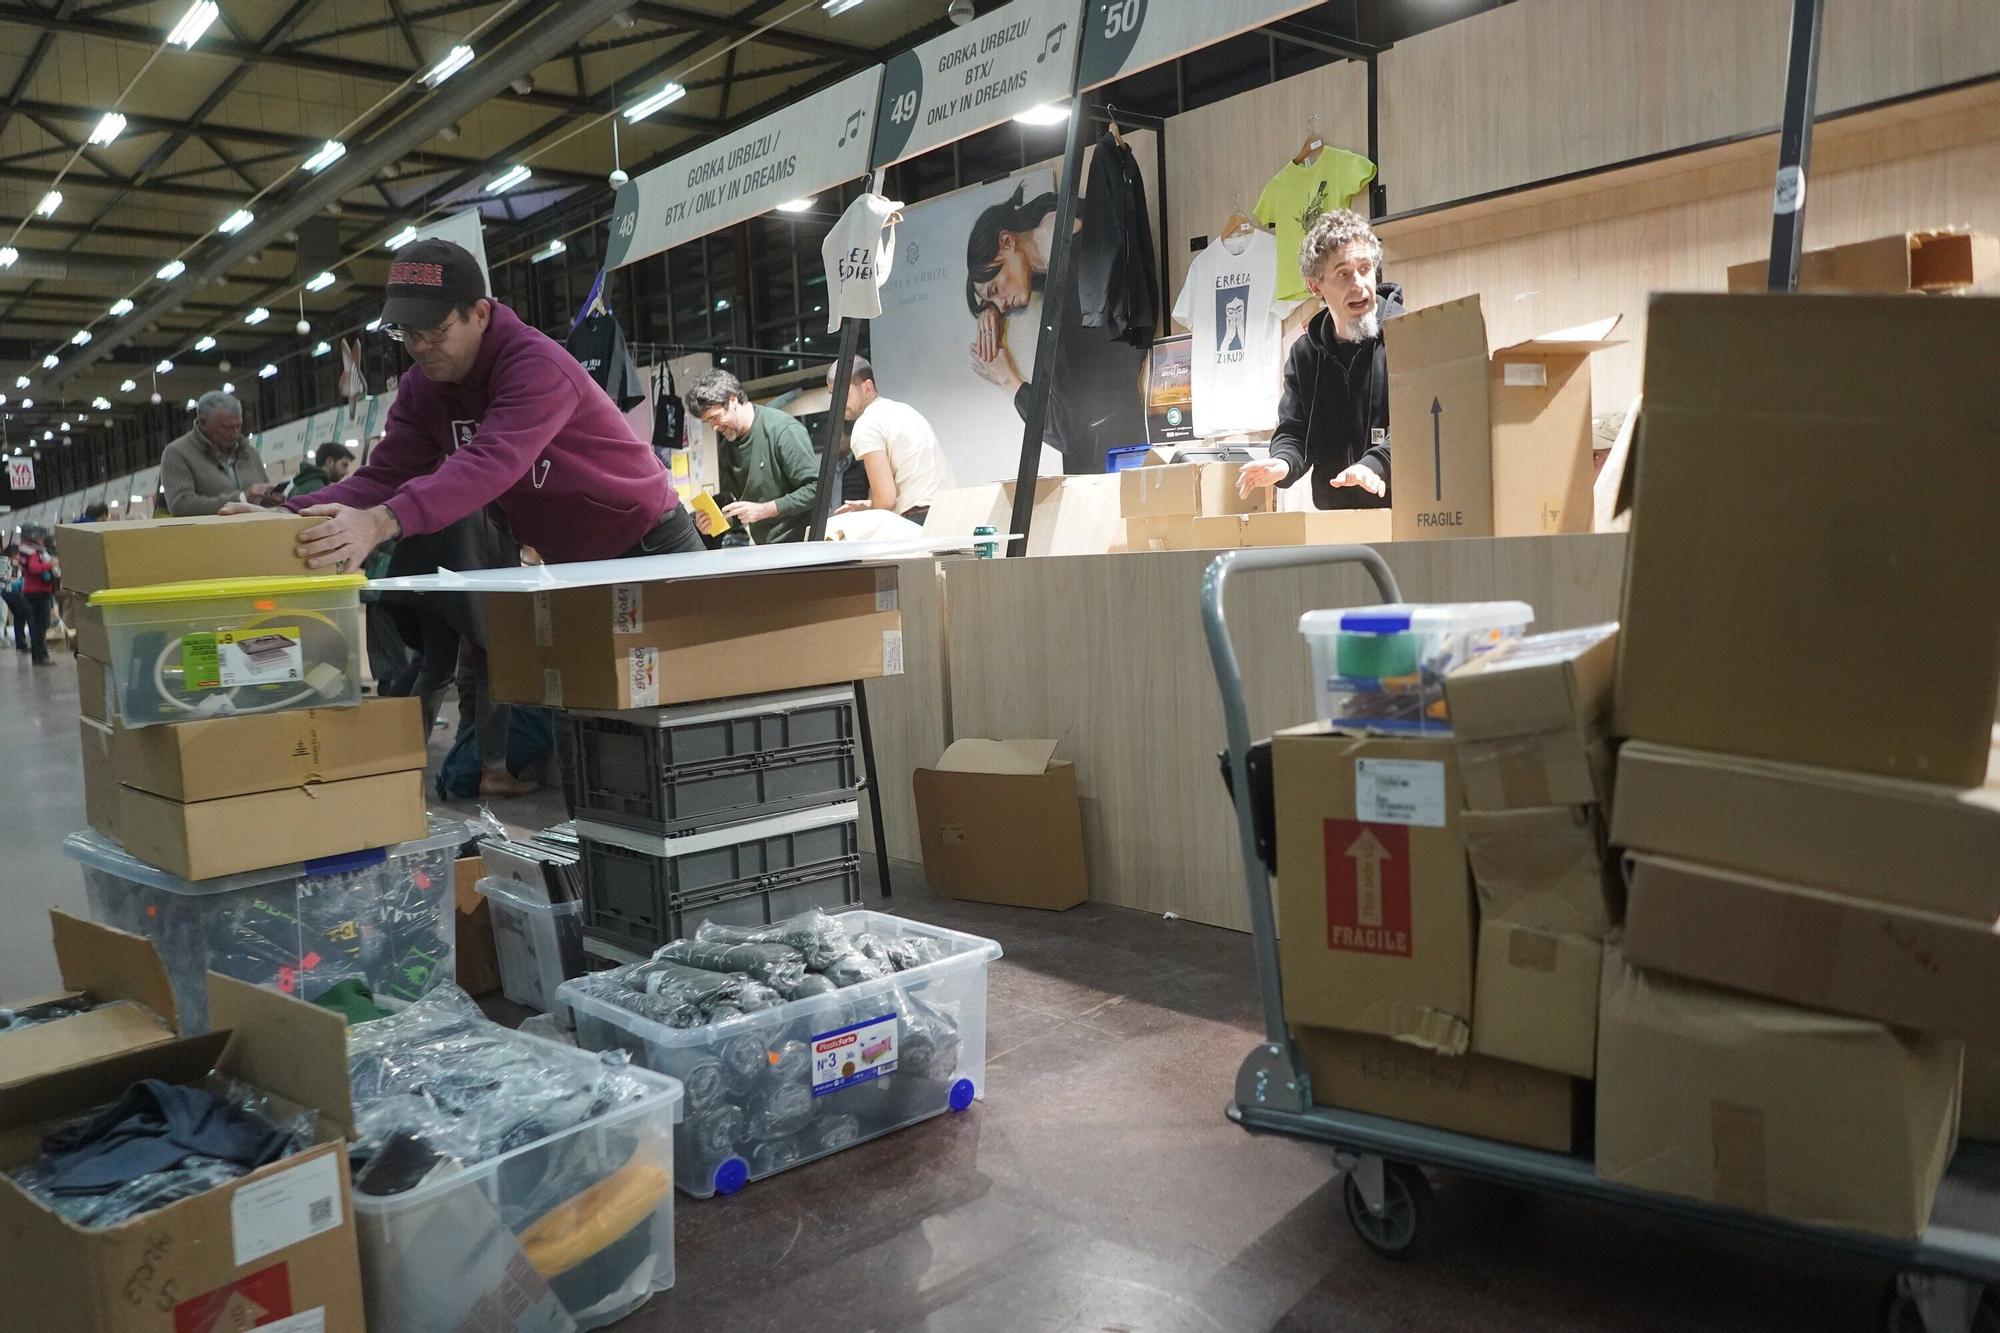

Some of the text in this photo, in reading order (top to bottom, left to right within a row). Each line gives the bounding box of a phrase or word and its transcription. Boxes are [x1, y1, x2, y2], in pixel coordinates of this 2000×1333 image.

[1104, 0, 1140, 40] 50
[938, 16, 1032, 73] GORKA URBIZU/
[965, 58, 994, 86] BTX/
[890, 89, 918, 125] 49
[927, 69, 1028, 126] ONLY IN DREAMS
[687, 155, 724, 189] GORKA
[727, 134, 772, 171] URBIZU
[665, 205, 686, 226] BTX
[695, 183, 727, 213] ONLY
[728, 176, 740, 199] IN
[742, 154, 797, 195] DREAMS
[618, 212, 635, 239] 48
[1416, 511, 1463, 528] FRAGILE
[1332, 925, 1408, 952] FRAGILE
